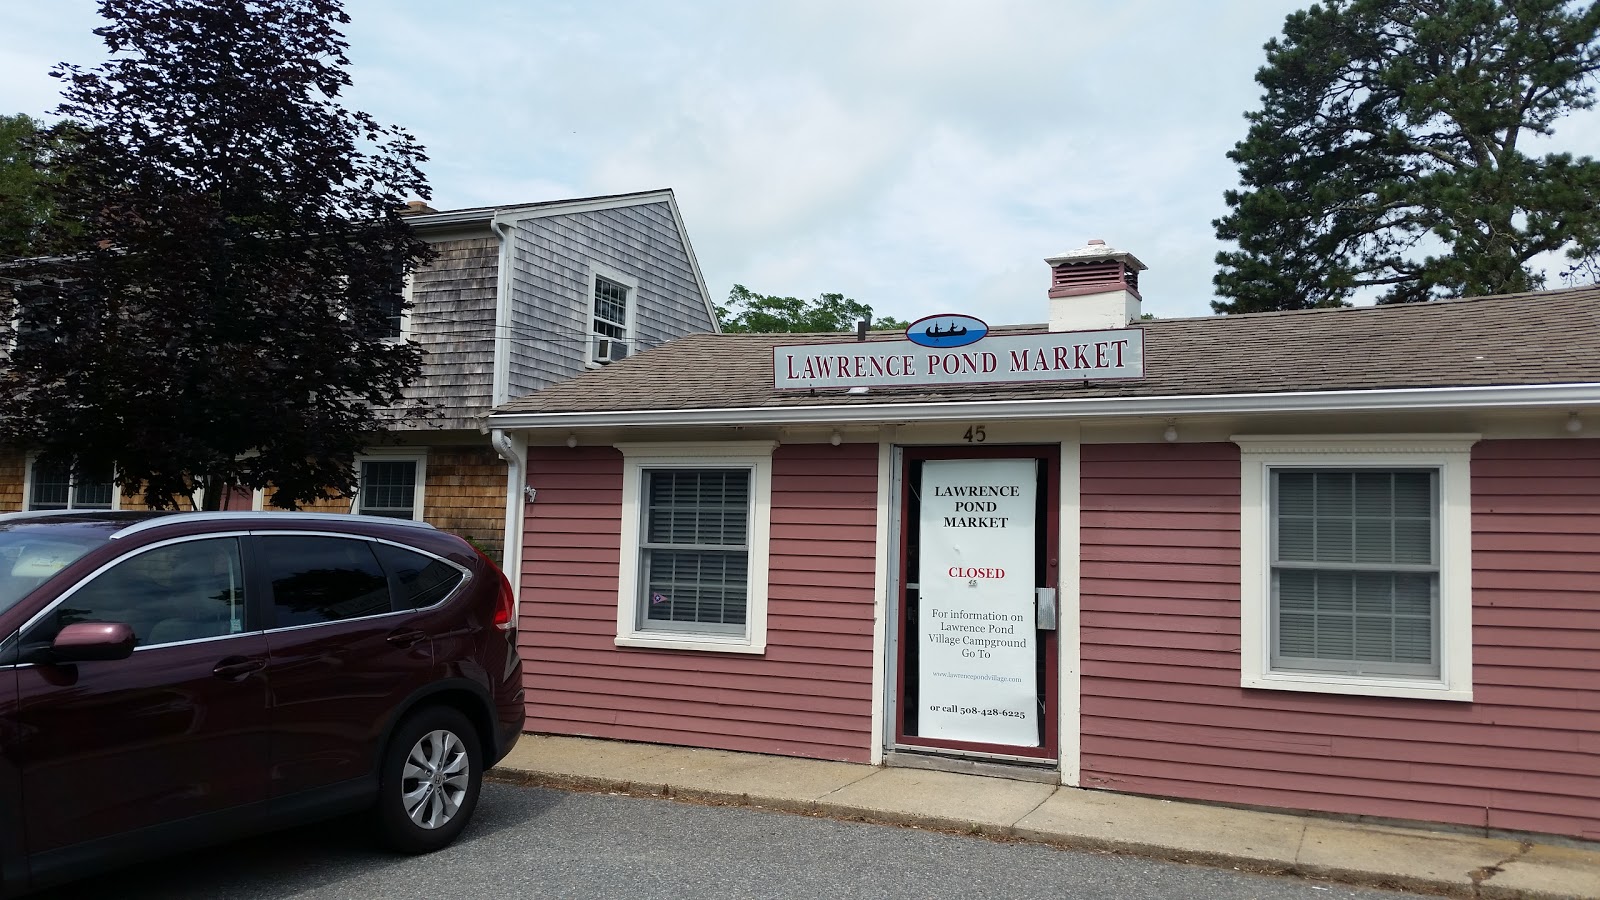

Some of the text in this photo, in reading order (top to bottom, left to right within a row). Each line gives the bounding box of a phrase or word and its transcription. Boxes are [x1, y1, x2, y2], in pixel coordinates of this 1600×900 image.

[786, 338, 1129, 380] LAWRENCE POND MARKET
[963, 425, 986, 442] 45
[935, 486, 1020, 497] LAWRENCE
[955, 501, 997, 512] POND
[944, 517, 1008, 528] MARKET
[948, 567, 1005, 579] CLOSED
[932, 609, 1024, 622] For information on
[941, 622, 1014, 634] Lawrence Pond
[928, 634, 1027, 648] Village Campground
[962, 649, 991, 659] Go To
[932, 671, 1022, 683] www.lawrencepondvillage.com
[942, 705, 958, 713] call
[960, 707, 1025, 719] 508-428-6225
